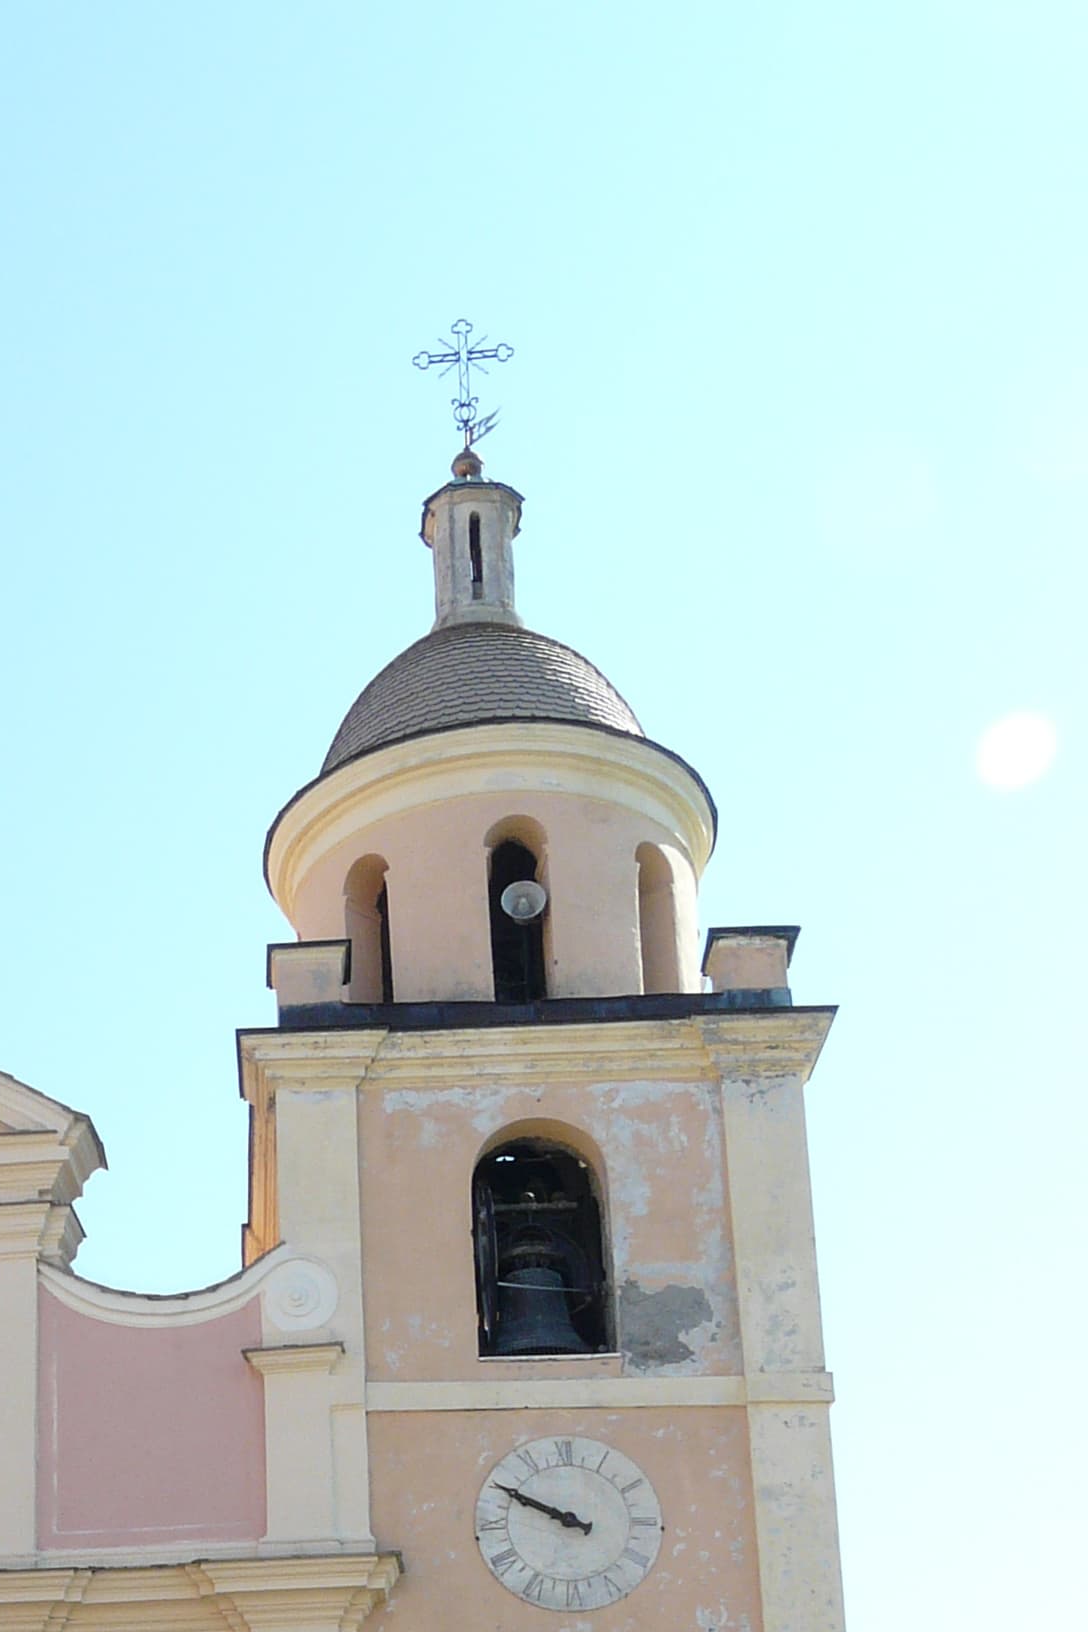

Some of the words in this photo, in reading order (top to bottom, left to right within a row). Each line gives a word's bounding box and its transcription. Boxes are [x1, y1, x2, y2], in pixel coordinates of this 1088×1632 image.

[595, 1450, 610, 1473] I
[620, 1478, 643, 1494] II
[630, 1516, 657, 1527] III
